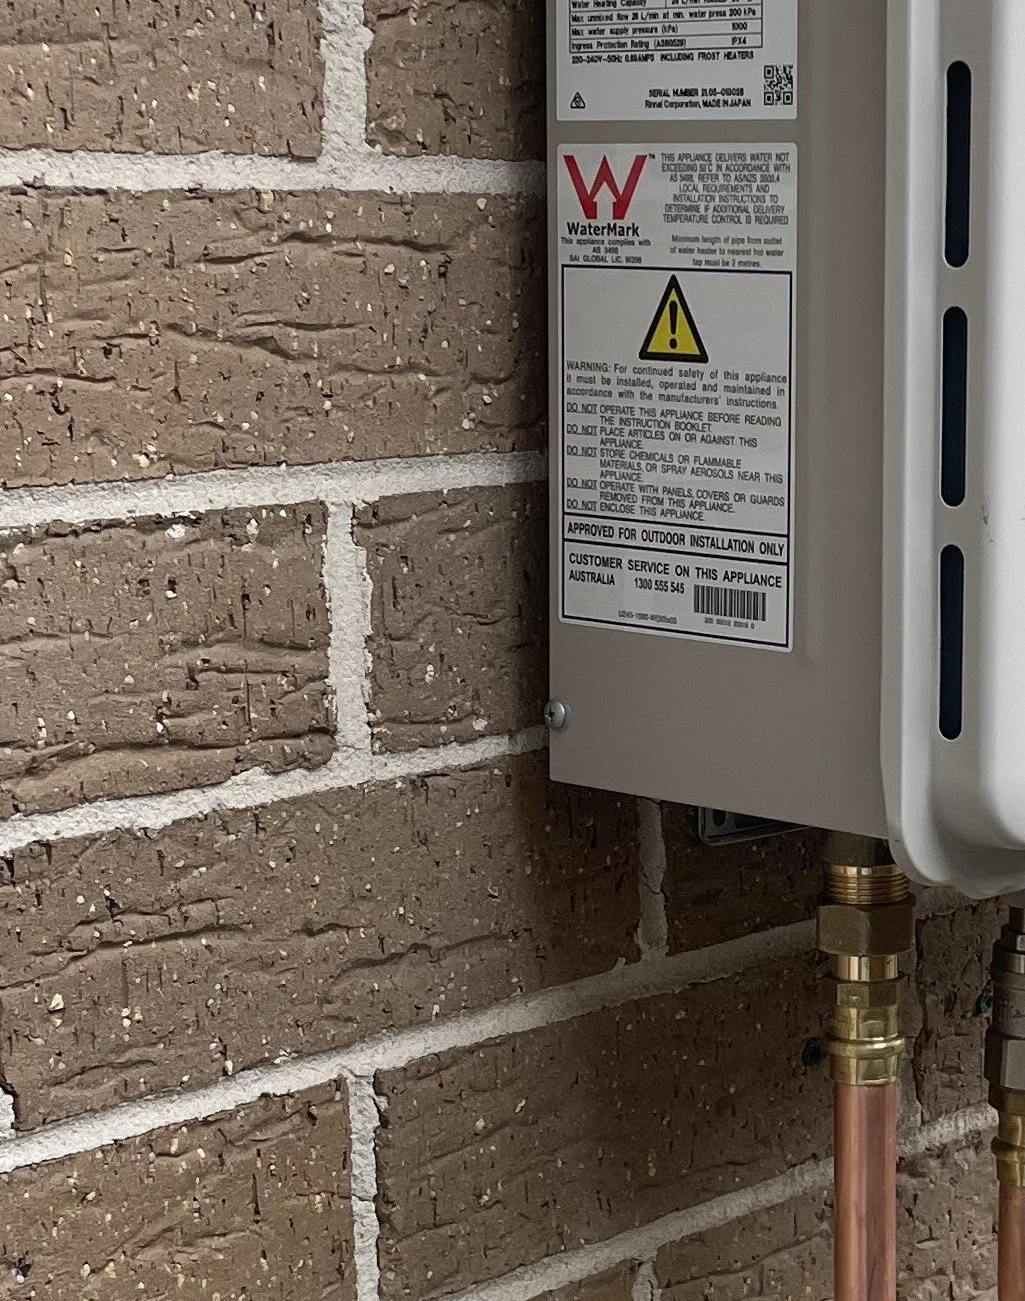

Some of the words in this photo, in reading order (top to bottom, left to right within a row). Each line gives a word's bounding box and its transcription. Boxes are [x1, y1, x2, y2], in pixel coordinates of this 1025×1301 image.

[661, 153, 675, 162] THIS
[677, 153, 712, 162] APPLIANCE
[715, 153, 747, 162] DELIVERS
[750, 153, 772, 163] WATER
[776, 153, 790, 163] NOT
[567, 222, 640, 237] WaterMark
[566, 361, 610, 372] WARNING:
[614, 363, 628, 374] For
[632, 364, 674, 376] continued
[678, 368, 704, 381] safety
[710, 369, 718, 379] of
[724, 370, 740, 381] this
[745, 372, 788, 384] appliance
[566, 374, 572, 382] it
[576, 376, 597, 384] must
[602, 376, 612, 386] be
[617, 376, 654, 389] installed,
[658, 380, 697, 392] operated
[702, 382, 718, 392] and
[724, 382, 772, 396] maintained
[776, 386, 786, 396] in
[566, 387, 613, 398] accordance
[618, 389, 634, 400] with
[640, 390, 654, 400] the
[566, 402, 578, 412] DO
[582, 404, 598, 414] NOT
[600, 404, 636, 417] OPERATE
[639, 408, 656, 418] THIS
[660, 409, 704, 422] APPLIANCE
[708, 414, 740, 424] BEFORE
[744, 415, 782, 427] READING
[600, 416, 616, 426] THE
[619, 418, 671, 430] INSTRUCTION
[566, 424, 578, 434] DO
[582, 426, 598, 436] NOT
[600, 426, 624, 438] PLACE
[628, 430, 666, 442] ARTICLES
[668, 432, 680, 442] ON
[684, 432, 697, 442] OR
[700, 434, 735, 446] AGAINST
[739, 437, 758, 448] THIS
[566, 445, 578, 456] DO
[582, 447, 598, 458] NOT
[600, 448, 626, 459] STORE
[629, 450, 674, 463] CHEMICALS
[678, 454, 690, 464] OR
[694, 456, 742, 468] FLAMMABLE
[646, 462, 658, 472] OR
[661, 464, 688, 475] SPRAY
[690, 468, 734, 480] AEROSOLS
[738, 471, 760, 482] NEAR
[764, 472, 784, 484] THIS
[566, 478, 578, 488] DO
[582, 479, 598, 490] NOT
[600, 480, 636, 492] OPERATE
[638, 484, 659, 495] WITH
[697, 489, 730, 501] COVERS
[734, 492, 746, 504] OR
[750, 494, 786, 506] GUARDS
[600, 491, 638, 504] REMOVED
[641, 494, 664, 506] FROM
[668, 497, 686, 508] THIS
[566, 499, 578, 510] DO
[582, 500, 598, 512] NOT
[600, 502, 636, 514] ENCLOSE
[640, 506, 657, 516] THIS
[568, 522, 615, 540] APPROVED
[618, 526, 638, 542] FOR
[642, 529, 686, 546] OUTDOOR
[690, 534, 756, 554] INSTALLATION
[759, 541, 785, 558] ONLY
[569, 552, 622, 570] CUSTOMER
[628, 560, 670, 576] SERVICE
[675, 564, 690, 579] ON
[695, 566, 718, 582] THIS
[722, 571, 783, 588] APPLIANCE
[569, 570, 616, 586] AUSTRALIA
[634, 577, 652, 590] 1300
[654, 580, 670, 593] 555
[670, 582, 686, 595] 545
